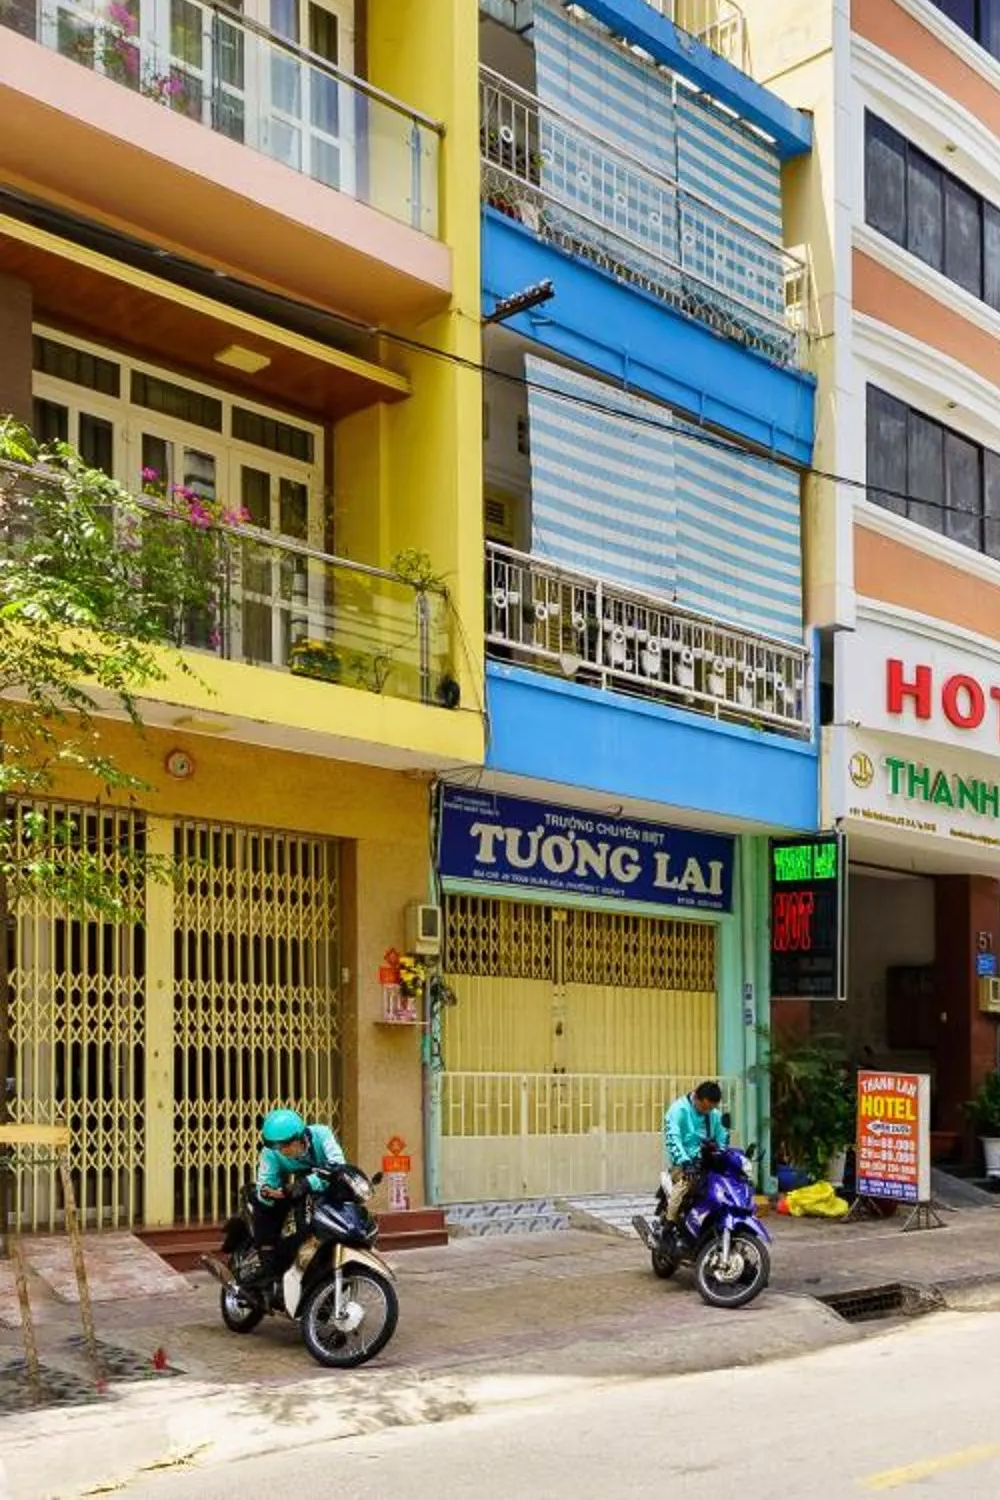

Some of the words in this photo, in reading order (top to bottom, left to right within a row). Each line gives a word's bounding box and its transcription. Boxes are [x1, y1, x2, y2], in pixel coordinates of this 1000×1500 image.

[884, 755, 1000, 820] THANH
[469, 822, 642, 883] TƯƠNG
[653, 851, 724, 896] LAI
[861, 1095, 916, 1121] HOTEL
